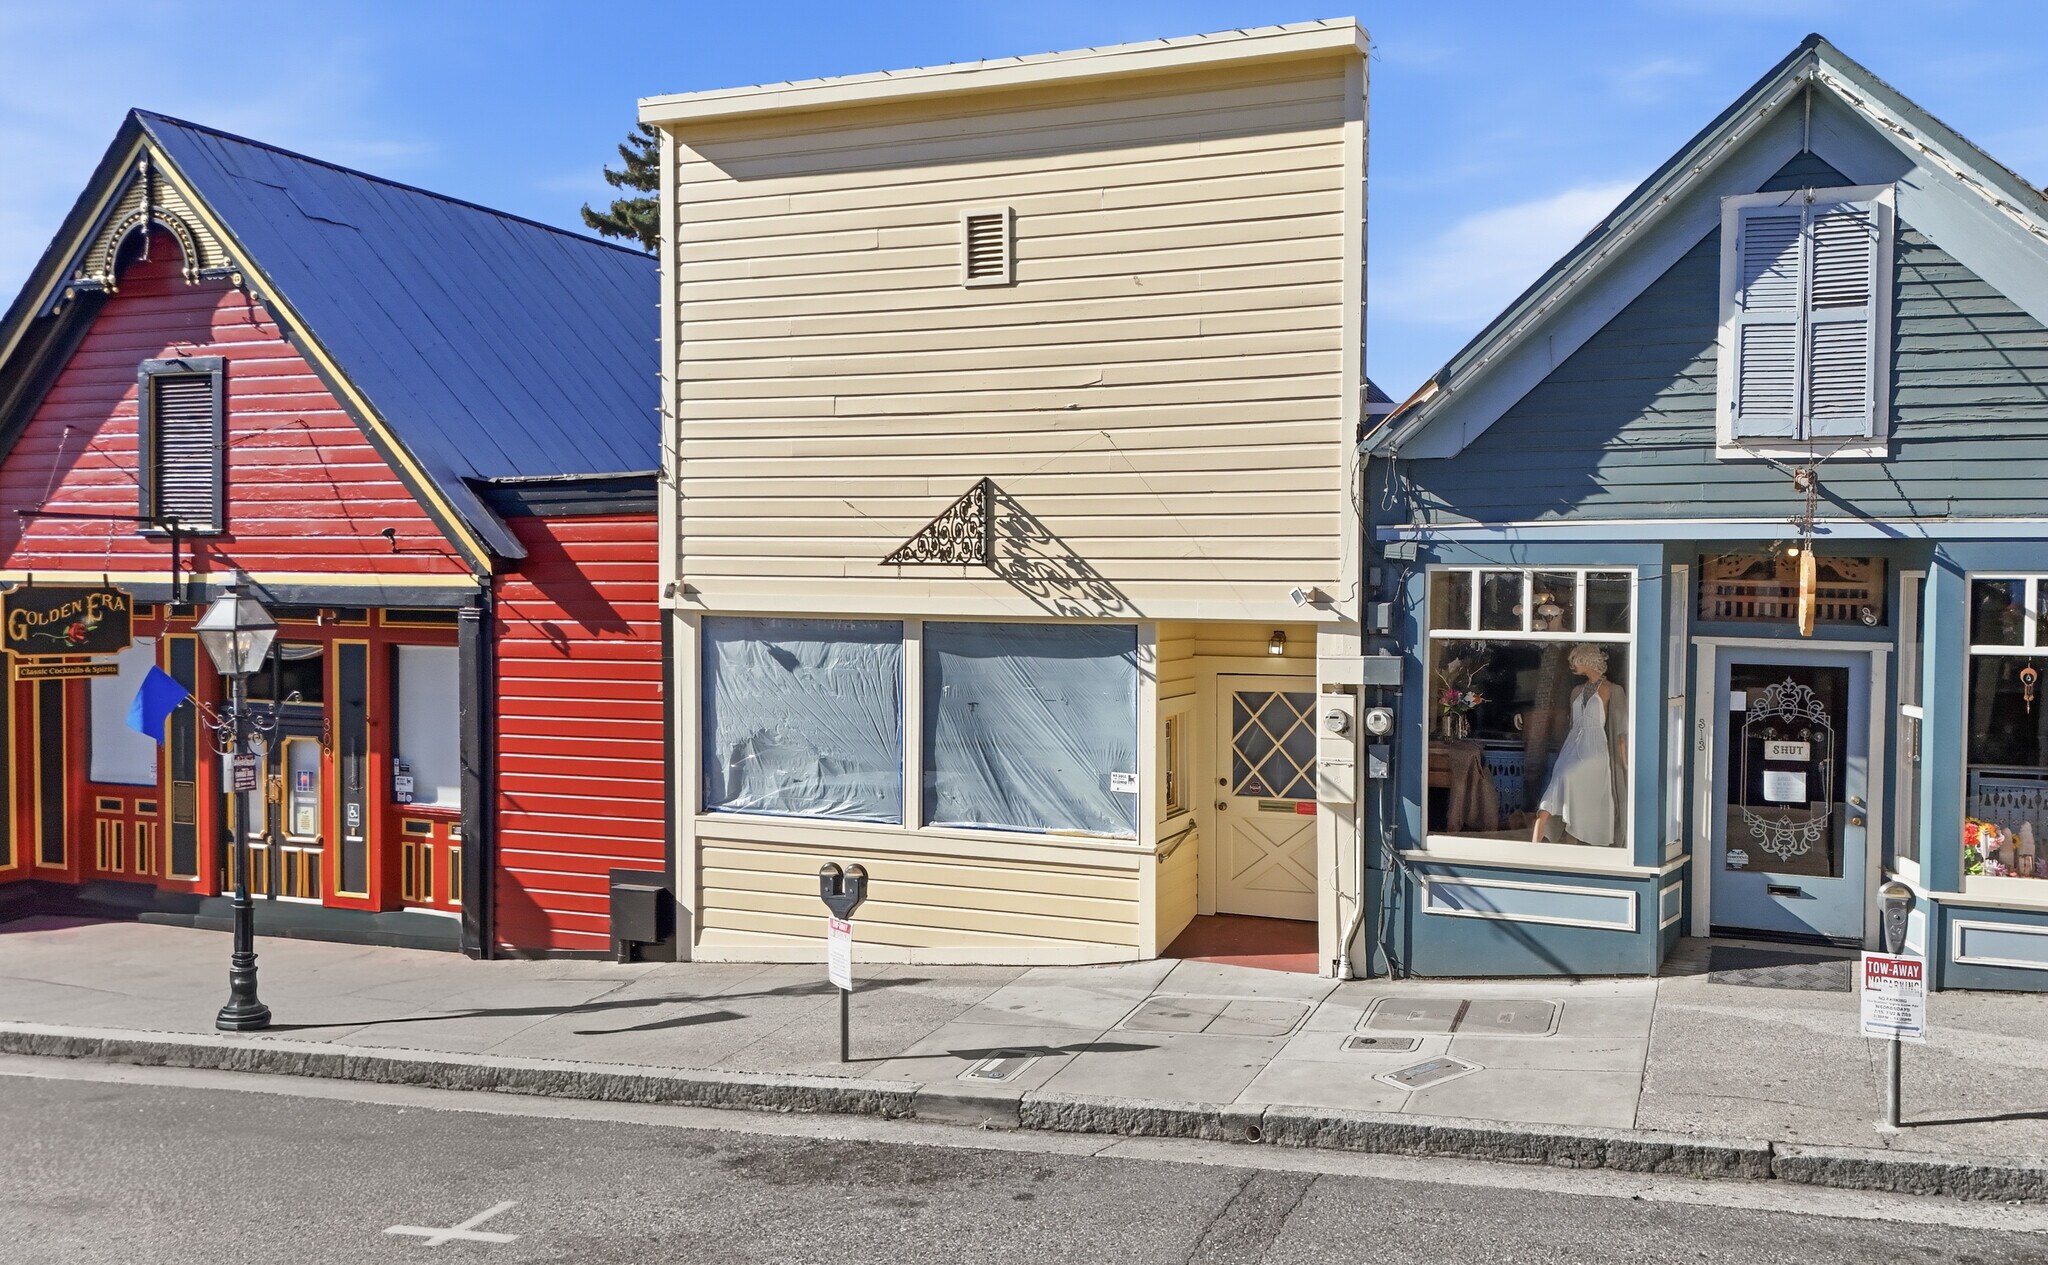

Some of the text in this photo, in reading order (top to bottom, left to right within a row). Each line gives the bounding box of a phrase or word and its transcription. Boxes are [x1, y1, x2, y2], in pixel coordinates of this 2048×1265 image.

[8, 592, 126, 641] GOLDEN ERA
[20, 667, 48, 676] Classic
[49, 666, 83, 675] Cocktails
[92, 665, 117, 674] Spirits
[1772, 745, 1804, 755] SHUT
[1867, 960, 1919, 978] TOW-AWAY
